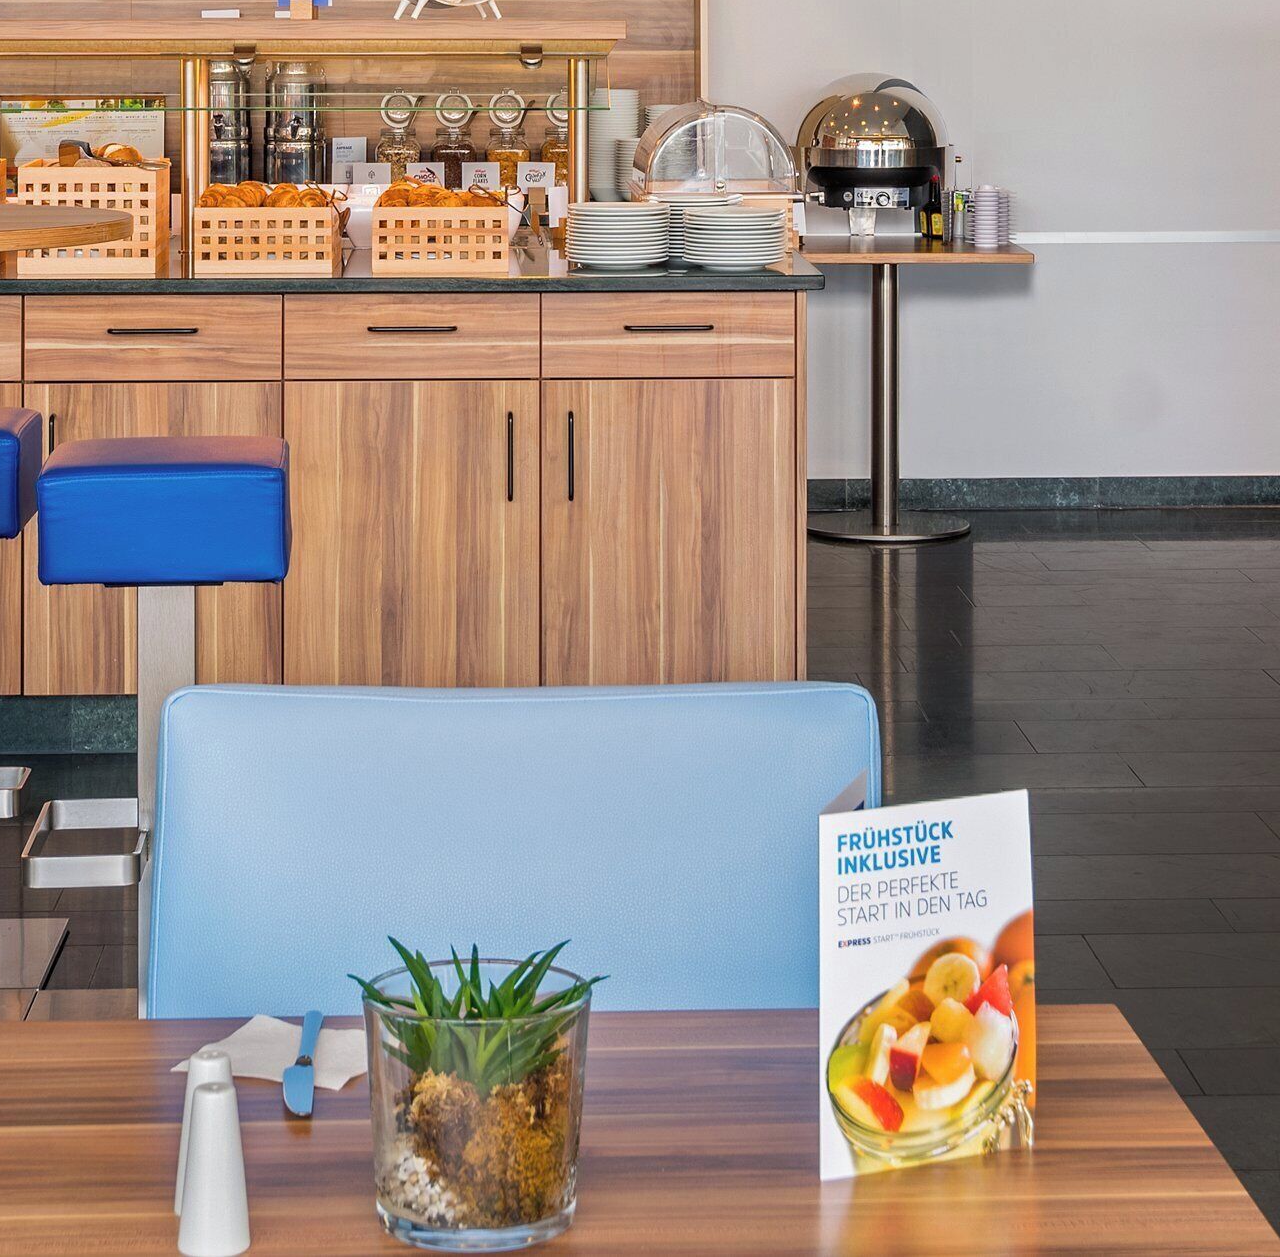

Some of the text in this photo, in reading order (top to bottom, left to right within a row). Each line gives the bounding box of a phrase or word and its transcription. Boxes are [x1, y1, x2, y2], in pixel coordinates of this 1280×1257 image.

[837, 820, 954, 852] FRÜHSTÜCK
[837, 844, 942, 875] INKLUSIVE
[837, 871, 959, 903] DER PERFEKTE
[837, 889, 988, 926] START IN DEN TAG
[837, 937, 871, 948] EXPRESS
[899, 928, 941, 940] FRÜHSTÜCK
